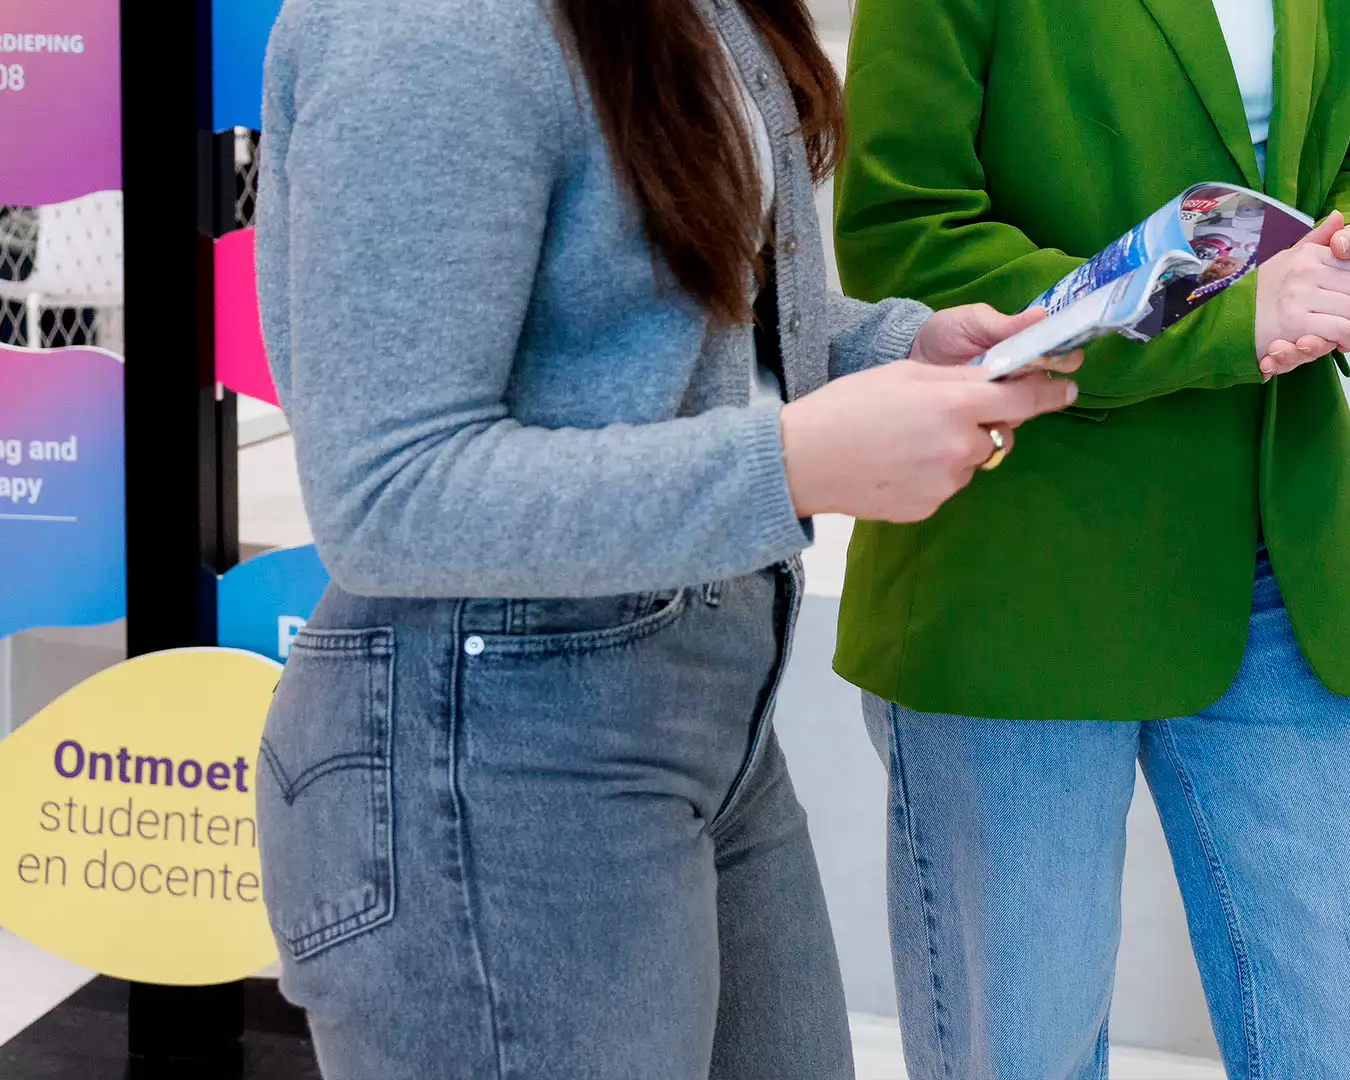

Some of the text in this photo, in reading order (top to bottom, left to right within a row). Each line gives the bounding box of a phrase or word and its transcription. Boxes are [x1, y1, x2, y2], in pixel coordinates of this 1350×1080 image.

[0, 33, 84, 53] DIEPING
[29, 435, 77, 461] and
[54, 740, 248, 792] Ontmoet
[40, 796, 256, 847] studenten
[18, 853, 67, 887] en
